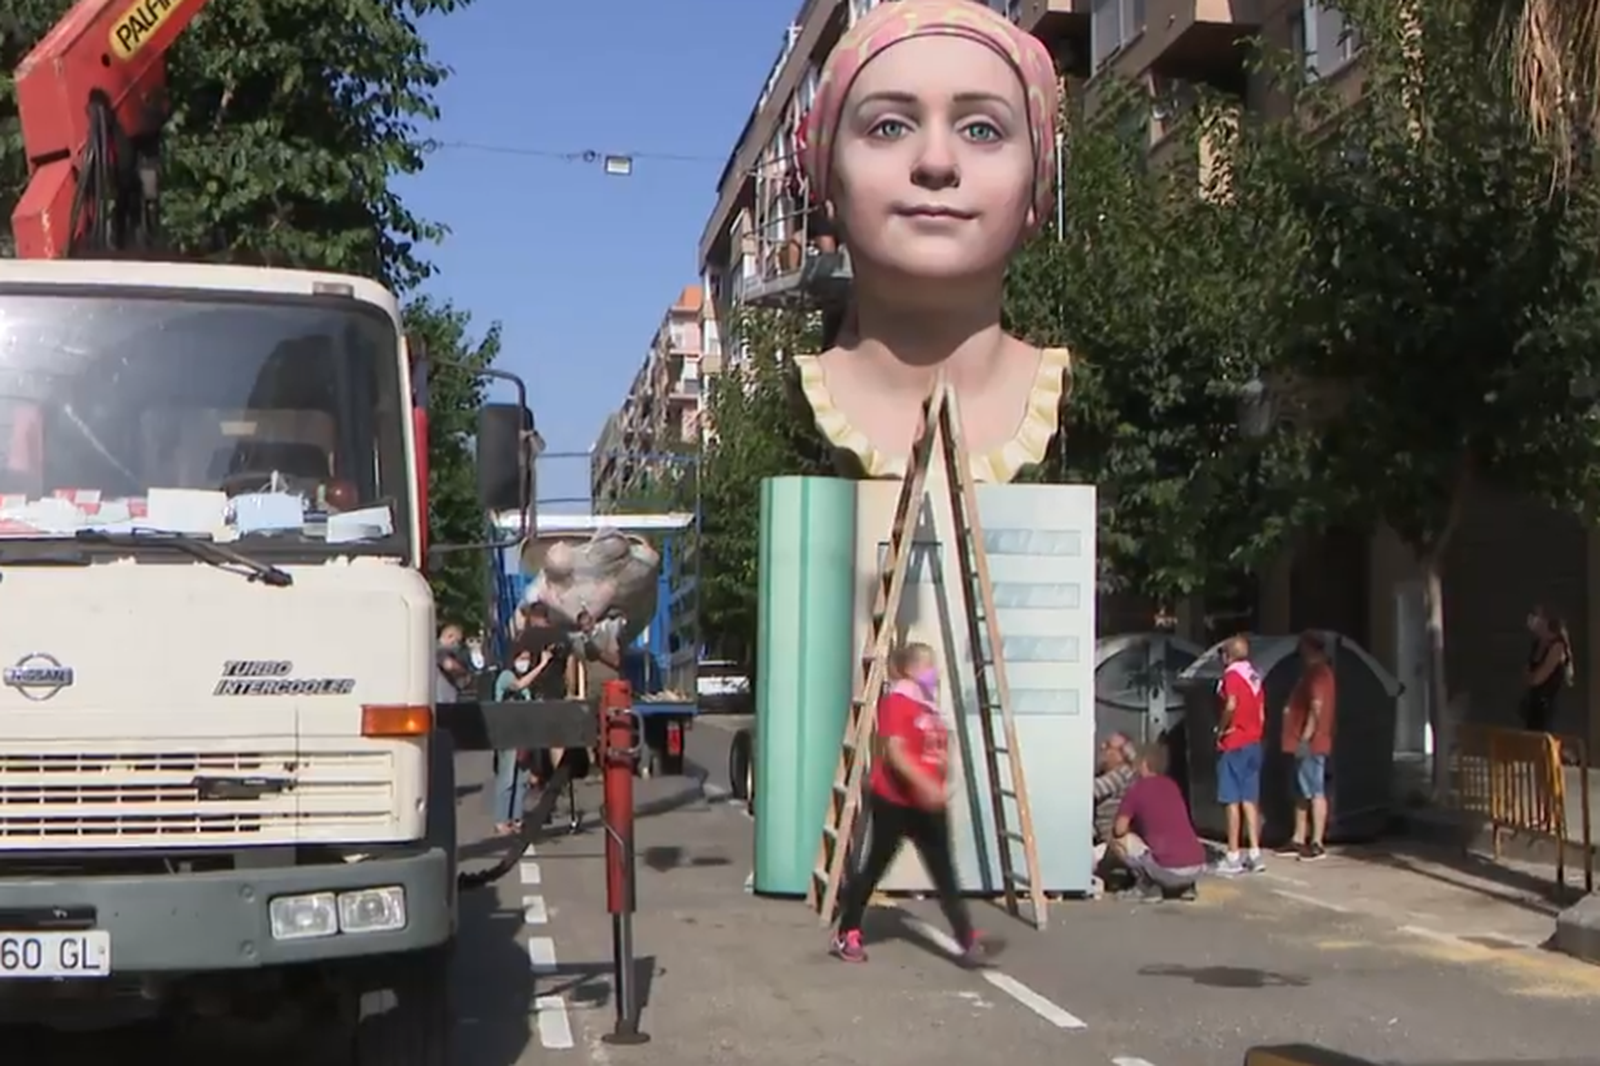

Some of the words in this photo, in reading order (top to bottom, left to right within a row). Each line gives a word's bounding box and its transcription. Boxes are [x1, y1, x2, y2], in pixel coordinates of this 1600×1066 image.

[222, 660, 294, 677] TURBO
[213, 678, 356, 696] INTERCOOLER
[1, 938, 42, 970] 60
[60, 937, 100, 969] GL
